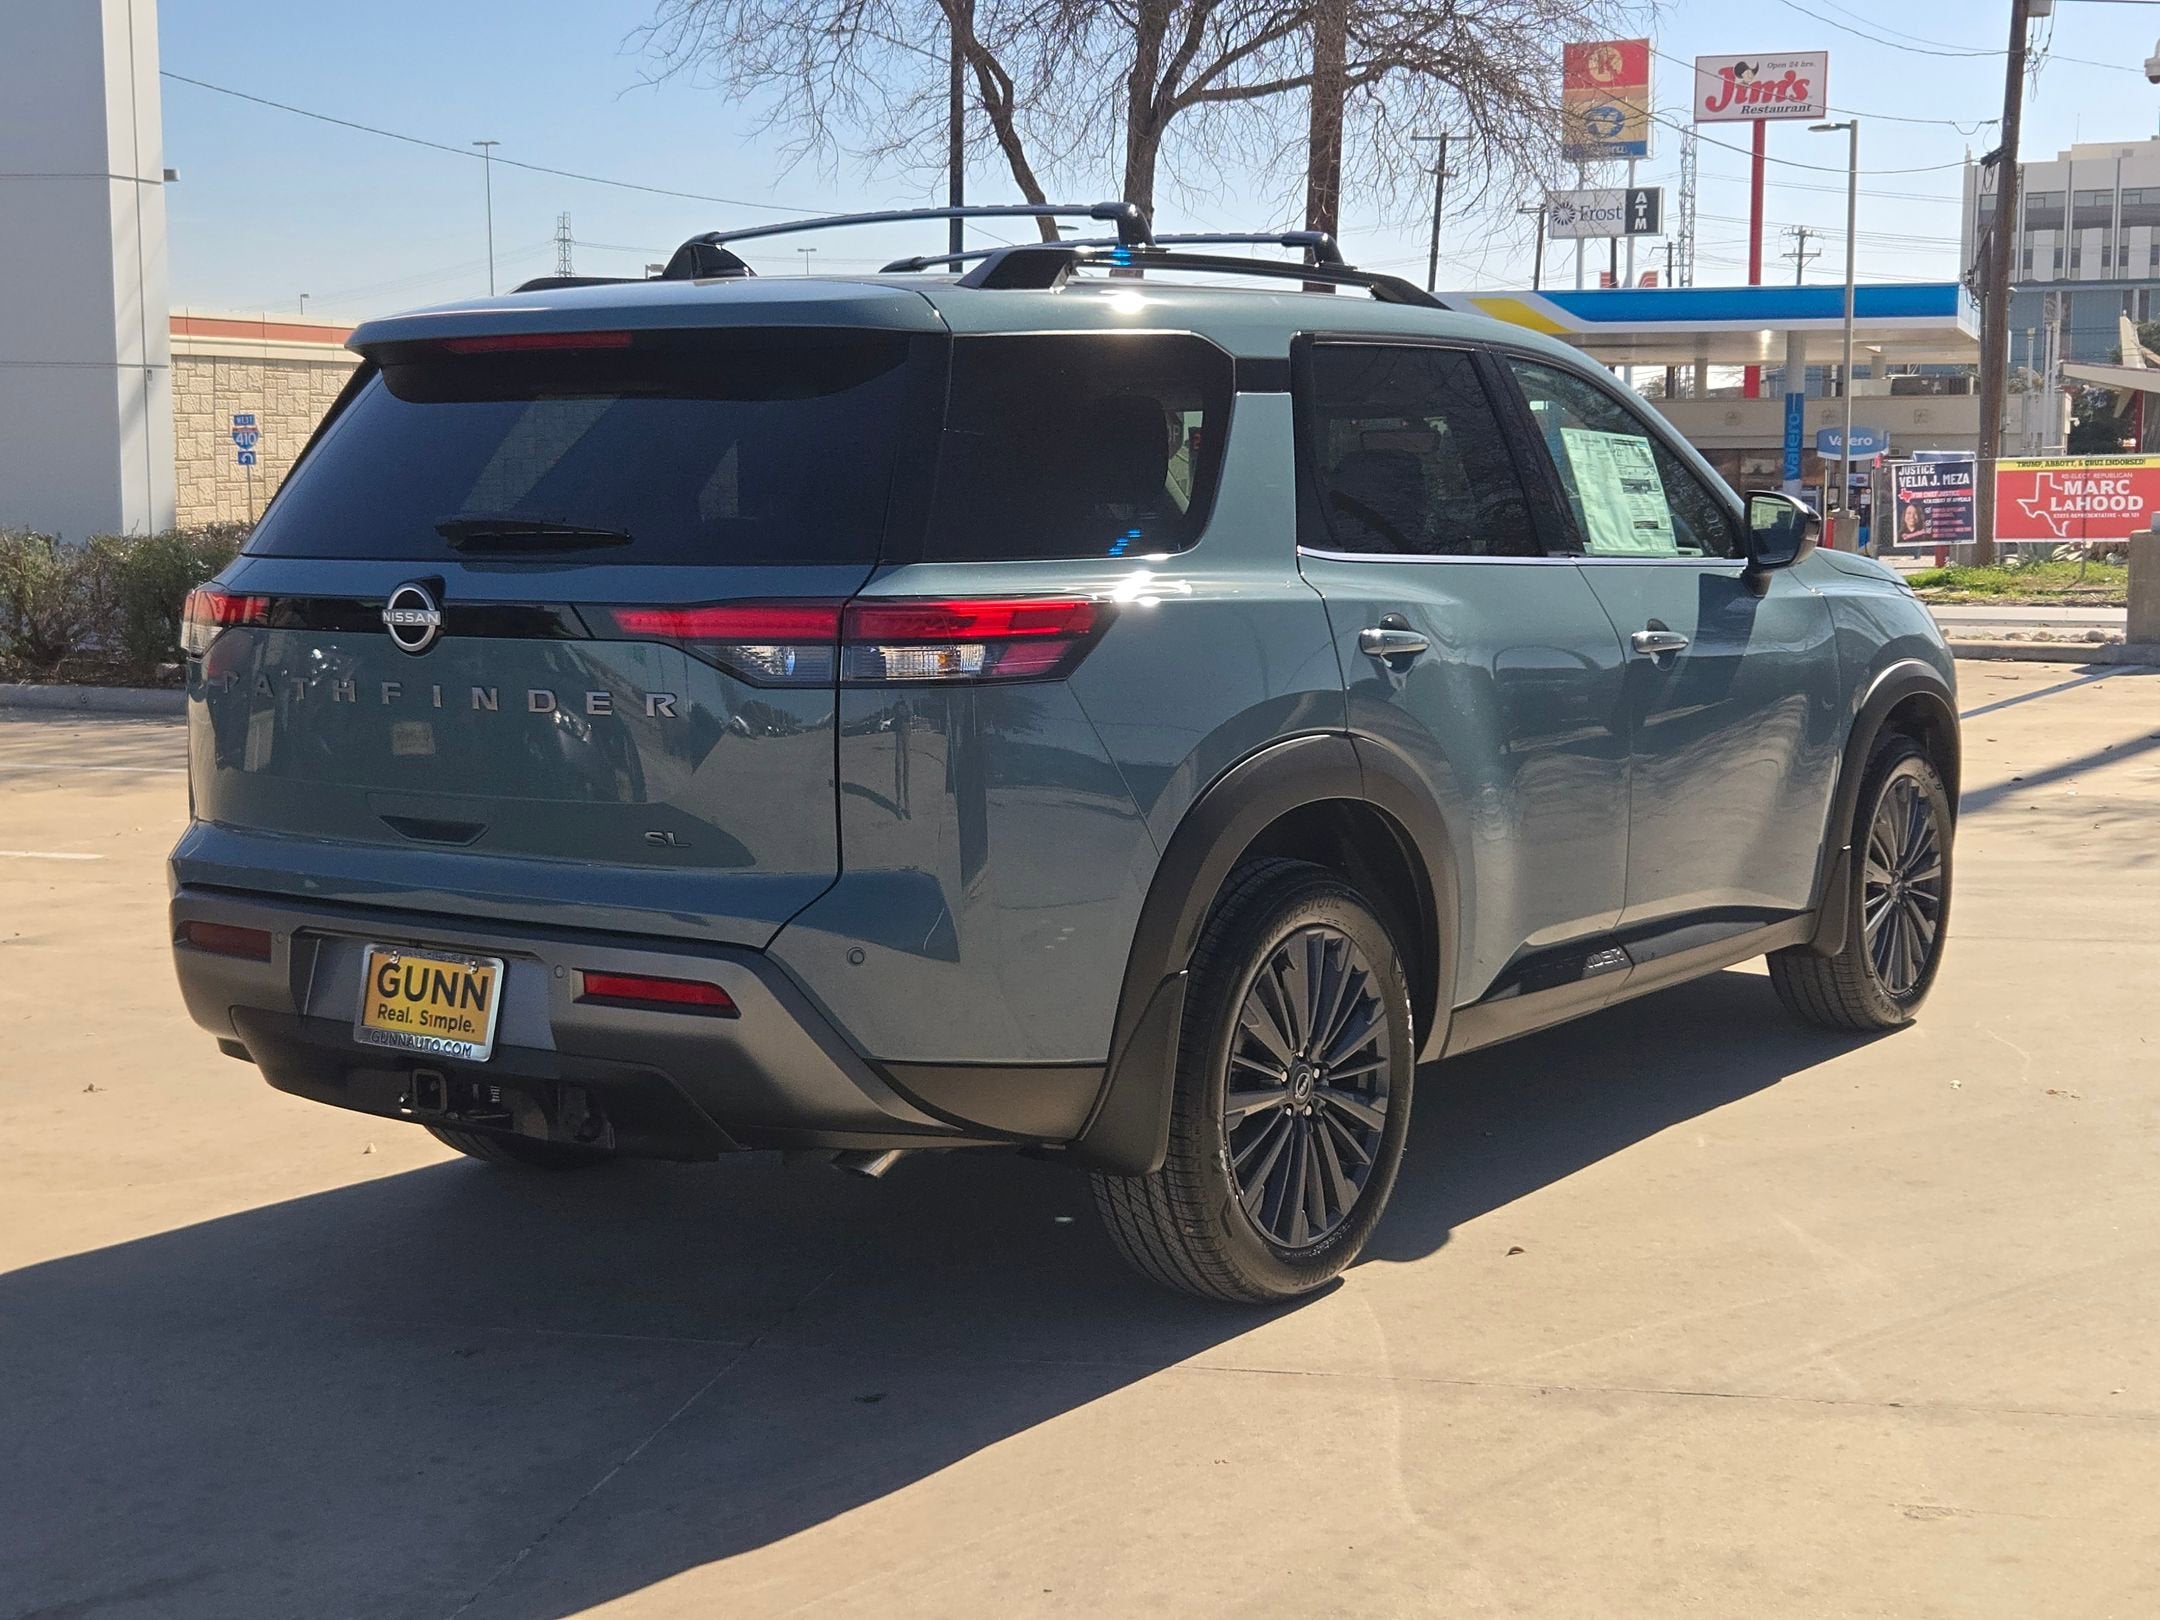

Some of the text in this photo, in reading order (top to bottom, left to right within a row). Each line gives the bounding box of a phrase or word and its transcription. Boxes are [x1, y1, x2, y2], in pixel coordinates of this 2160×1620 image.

[1767, 61, 1787, 71] Open
[1704, 65, 1810, 113] Jim's
[1740, 103, 1812, 114] Restaurant
[1579, 205, 1623, 221] Frost
[1634, 191, 1648, 231] ATM
[236, 432, 257, 446] 410
[1828, 435, 1873, 446] Vaero
[1898, 464, 1936, 476] JUSTICE
[1898, 472, 1971, 487] VELIA J. MEZA
[2064, 479, 2130, 496] MARC
[382, 609, 442, 627] NISSAN
[223, 670, 679, 719] PATHFINDER
[643, 829, 692, 848] SL
[376, 962, 489, 1012] GUNN
[377, 1003, 413, 1024] Real.
[370, 1030, 473, 1057] GUNNAUTO.COM
